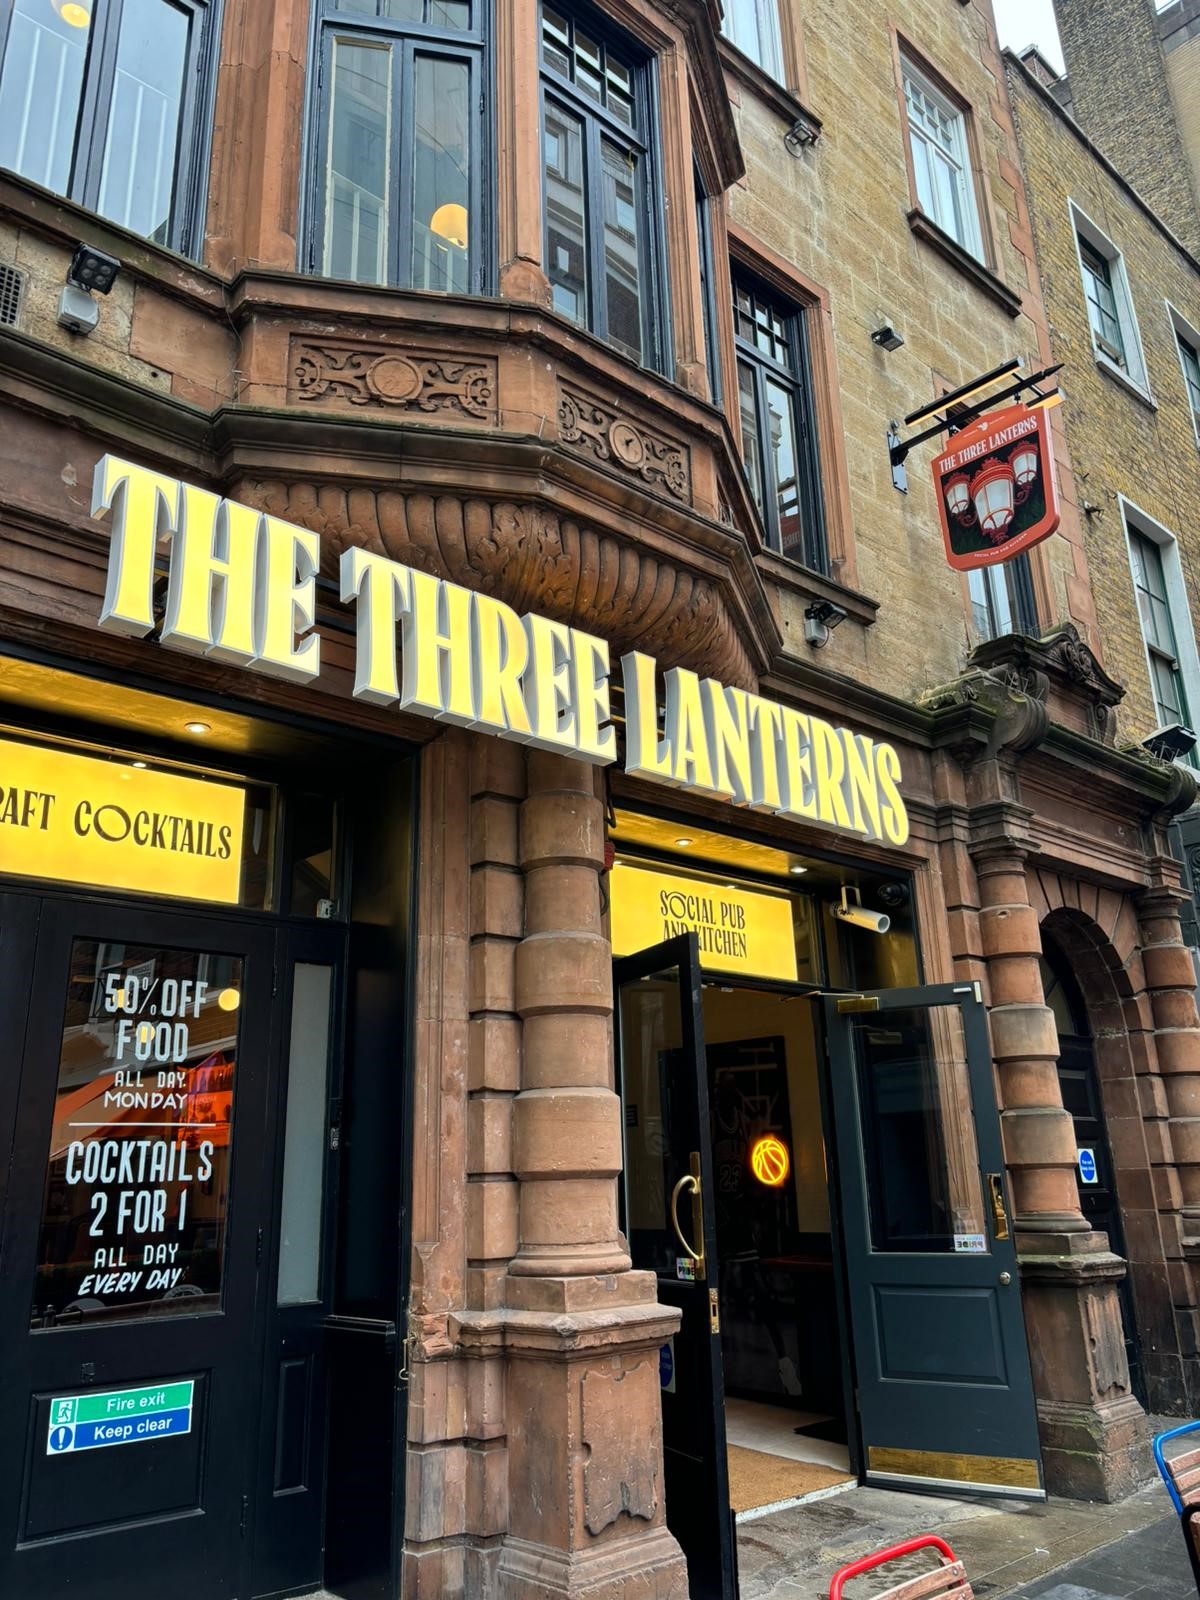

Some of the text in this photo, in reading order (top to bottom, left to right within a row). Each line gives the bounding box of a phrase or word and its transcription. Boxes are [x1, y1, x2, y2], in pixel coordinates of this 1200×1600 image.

[938, 415, 1038, 473] THE THREE LANTERNS
[91, 454, 910, 845] THE THREE LANTERNS
[0, 785, 232, 860] AFT COCKTAILS
[660, 890, 746, 930] SOCIAL PUB
[116, 1019, 189, 1063] FOOD
[114, 1071, 186, 1088] ALL DAY
[103, 1090, 188, 1110] MONDAY
[65, 1140, 214, 1185] COCKTAILS
[89, 1191, 108, 1237] 2
[117, 1189, 168, 1235] FOR
[94, 1243, 179, 1269] ALL DAY
[77, 1267, 182, 1296] EVERY DAY
[107, 1391, 166, 1413] Fire exit
[94, 1417, 173, 1441] Keep clear
